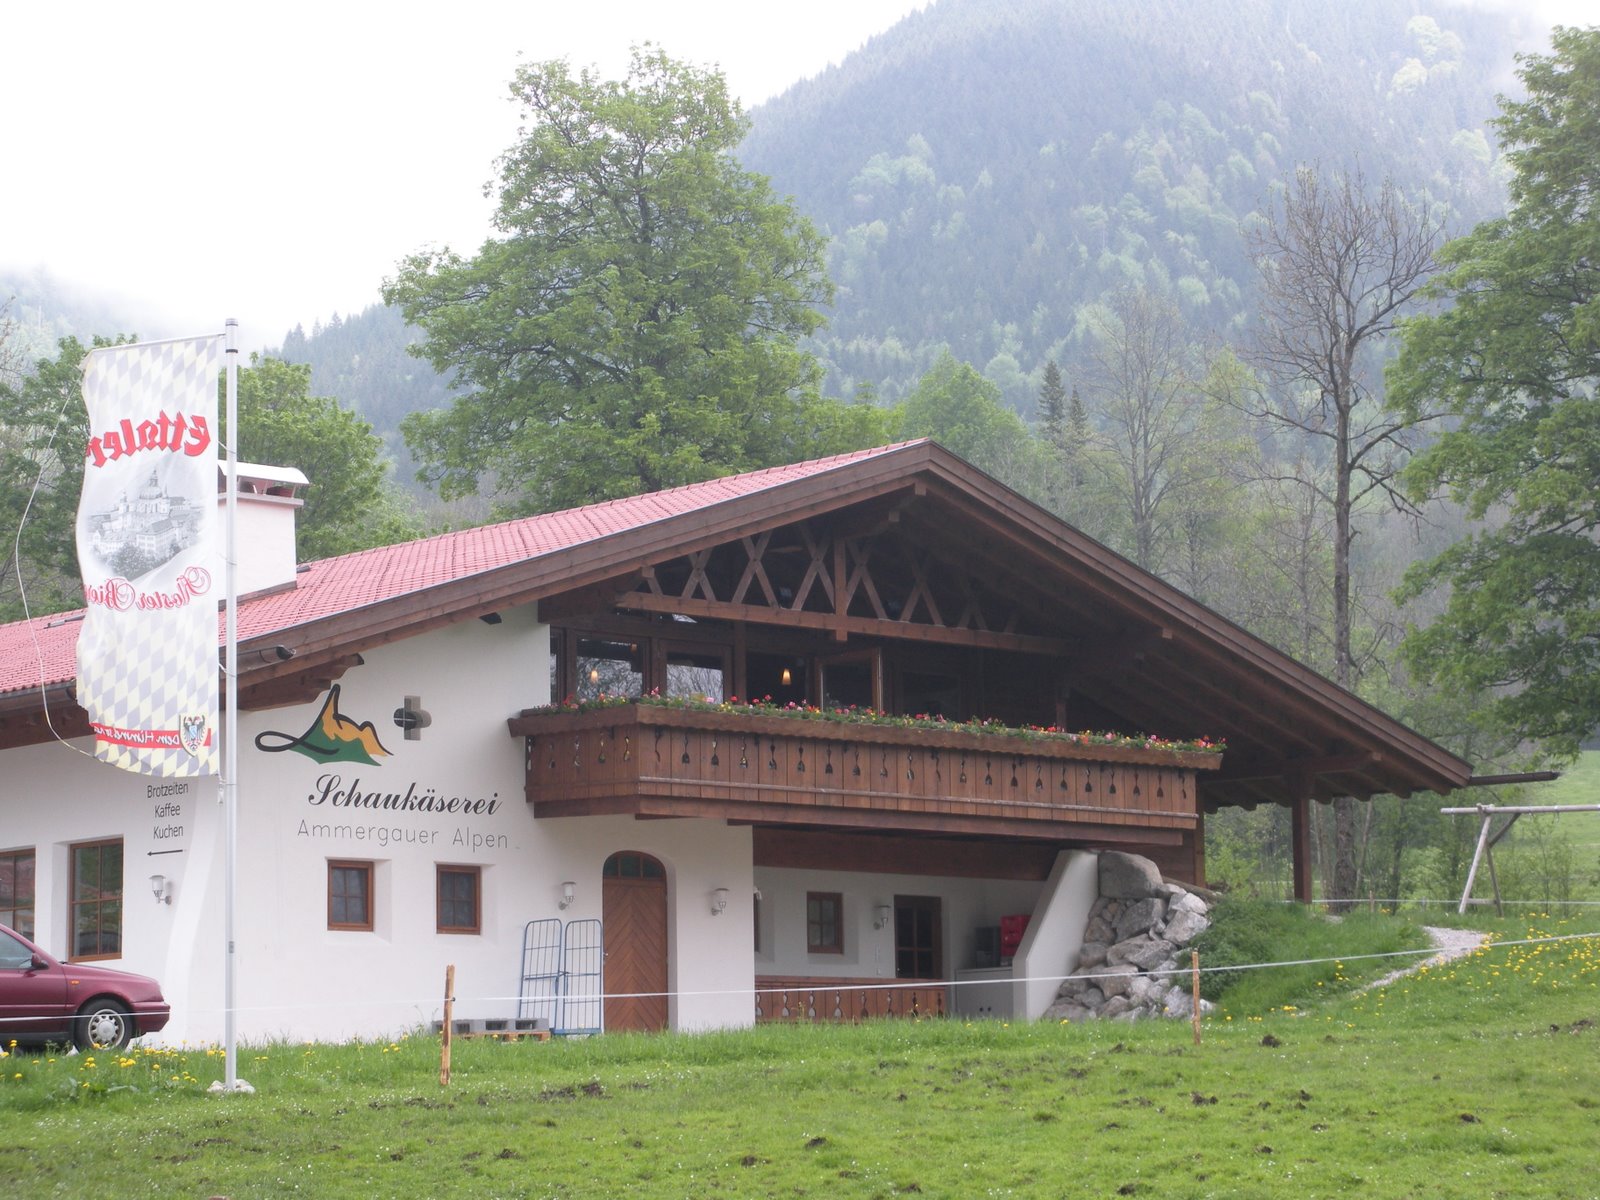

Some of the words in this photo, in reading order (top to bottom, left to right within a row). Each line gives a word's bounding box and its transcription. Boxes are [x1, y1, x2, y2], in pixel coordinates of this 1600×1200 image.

[147, 782, 189, 798] Brotzeiten
[308, 773, 503, 815] Schaukäserei
[154, 804, 181, 818] Kaffee
[153, 825, 184, 840] Kuchen
[297, 819, 439, 847] Ammergauer
[452, 826, 508, 853] Alpen
